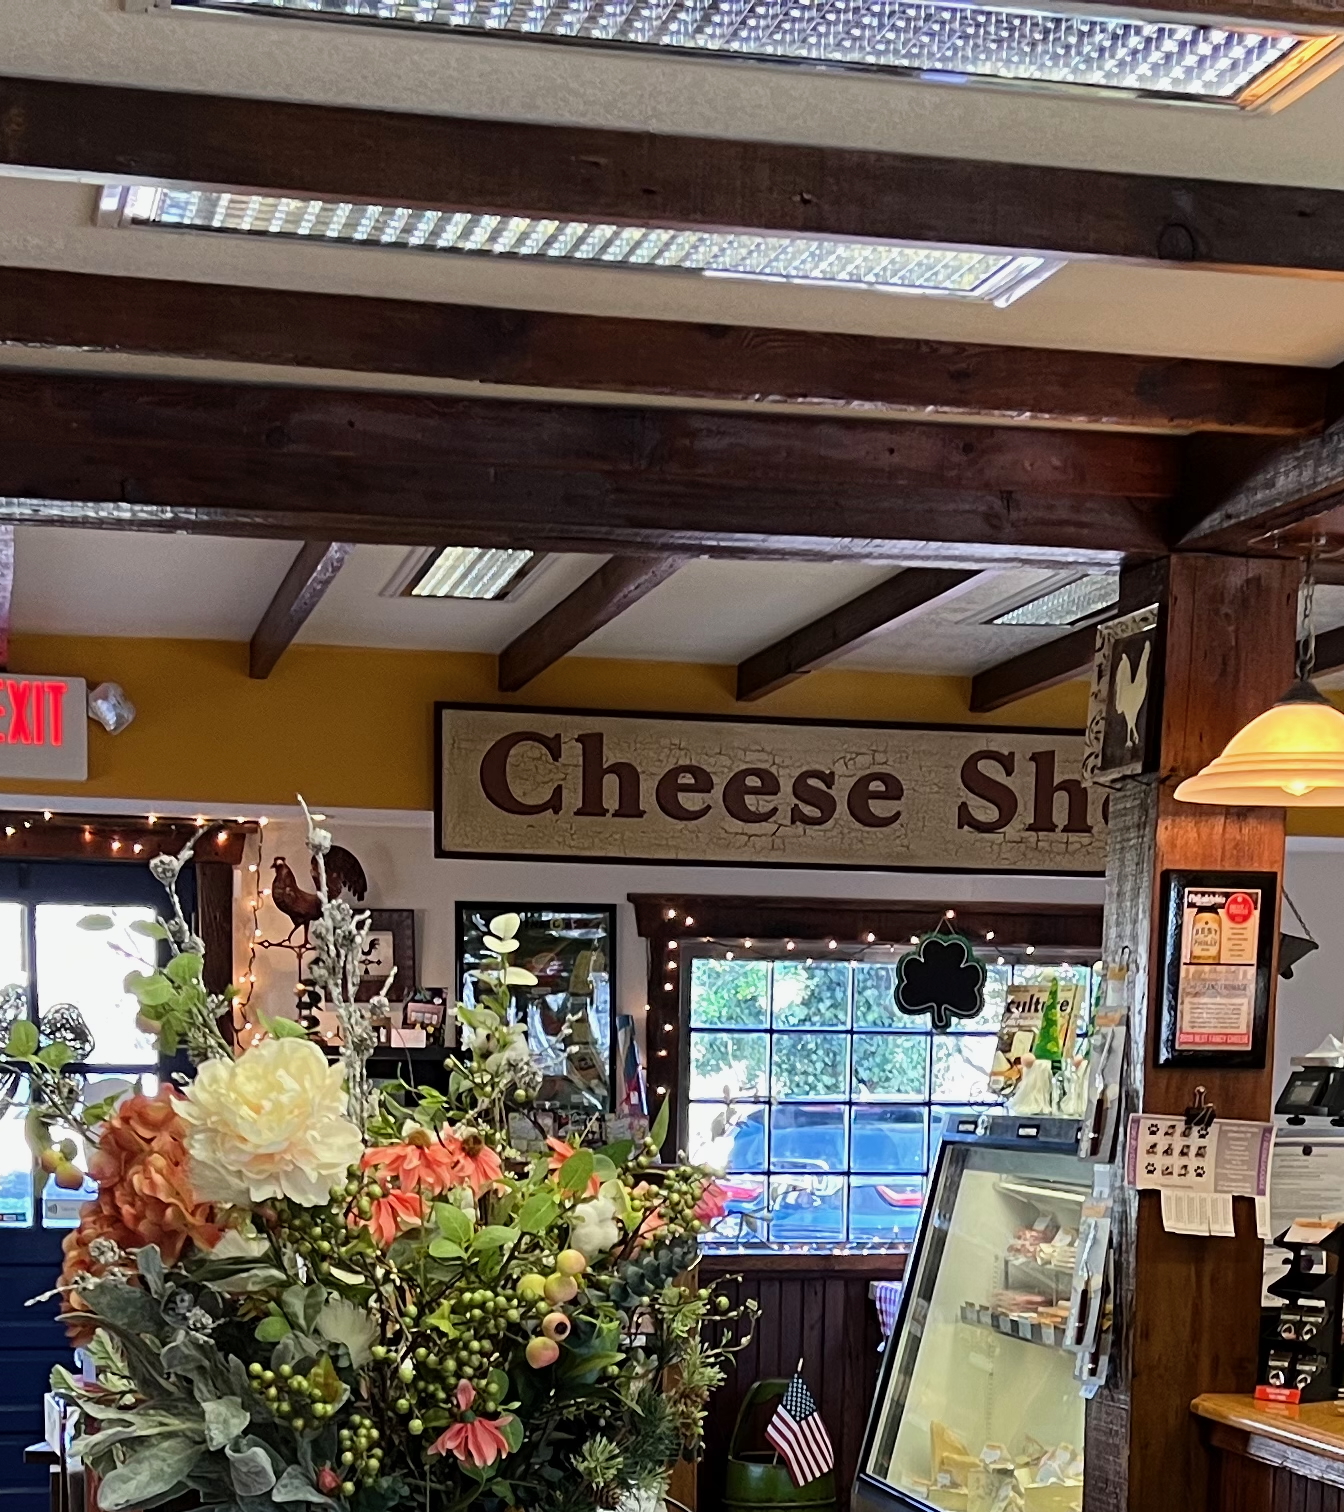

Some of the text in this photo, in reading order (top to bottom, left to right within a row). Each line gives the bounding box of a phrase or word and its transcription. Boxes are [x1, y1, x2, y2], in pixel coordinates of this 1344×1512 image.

[479, 731, 1105, 833] Cheese Sh
[1006, 993, 1069, 1013] culte
